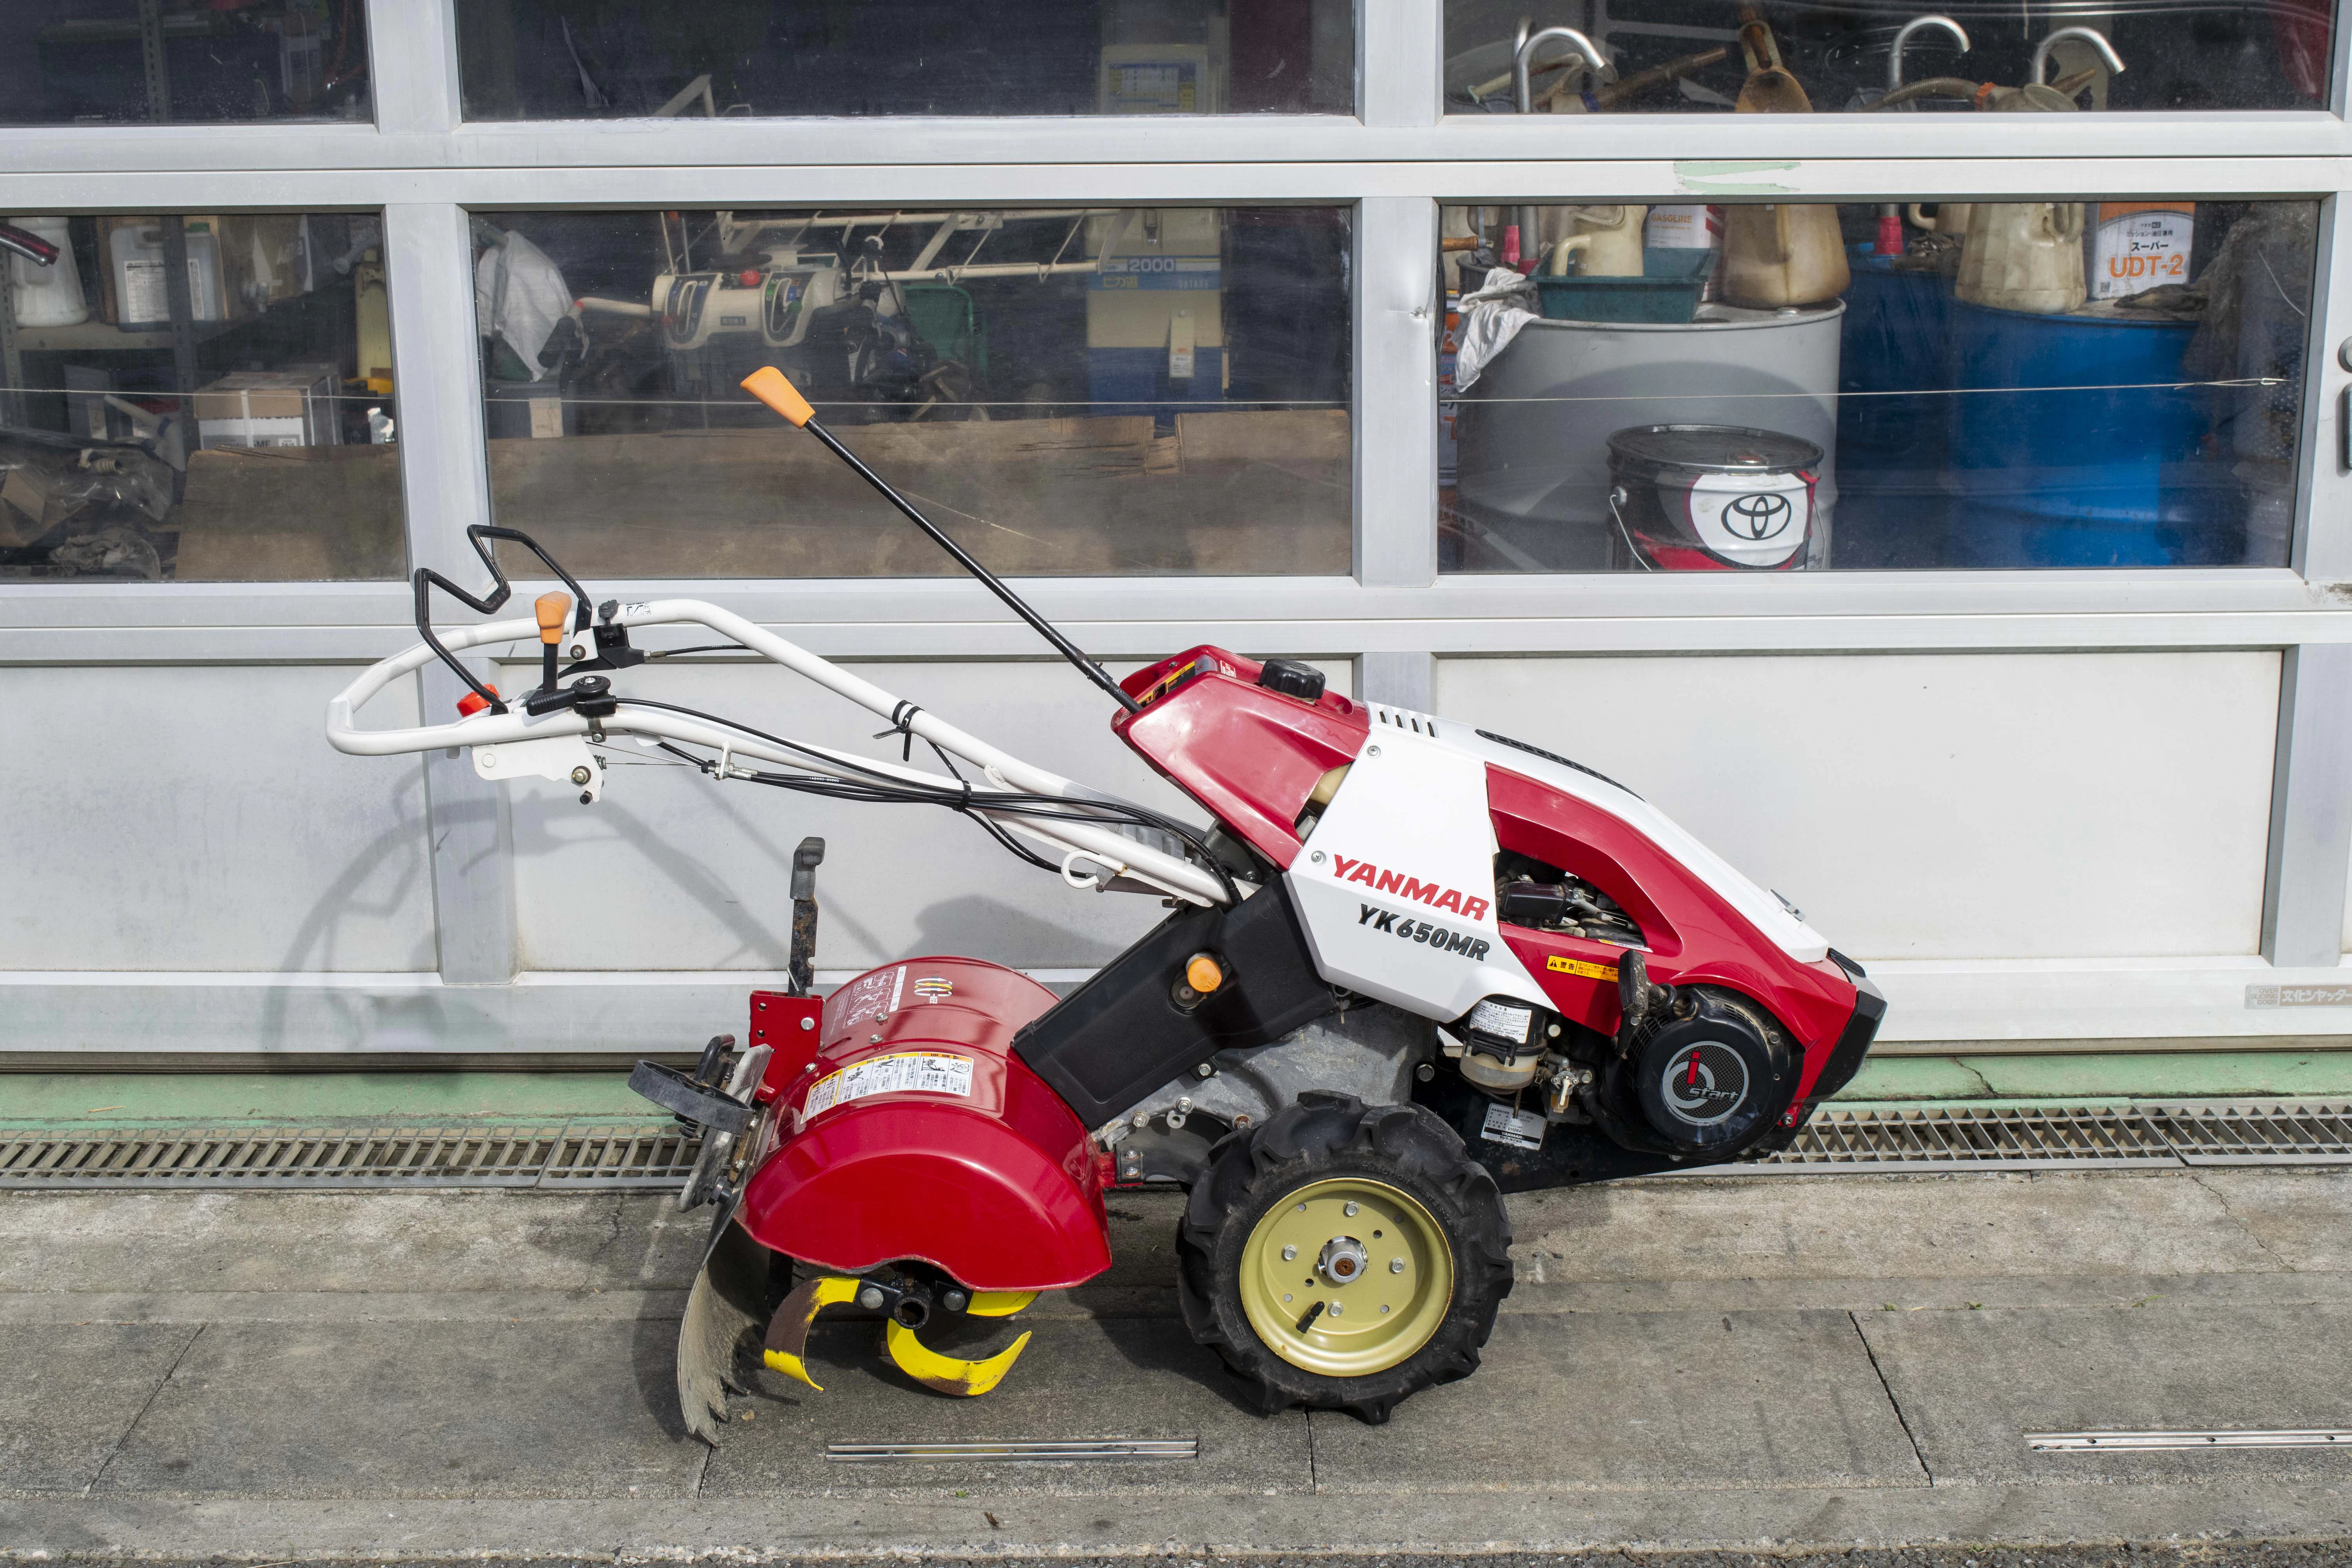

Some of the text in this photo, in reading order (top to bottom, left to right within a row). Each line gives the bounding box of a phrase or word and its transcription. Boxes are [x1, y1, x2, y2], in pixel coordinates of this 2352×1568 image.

[1651, 213, 1692, 223] GASOLINE
[1129, 258, 1175, 272] 2000
[2110, 254, 2183, 278] UDT-2
[1334, 854, 1490, 921] YANMAR
[1357, 903, 1490, 961] YK650MR
[1560, 961, 1575, 970] 警告
[1203, 977, 1218, 988] OIL
[1687, 1087, 1740, 1102] start
